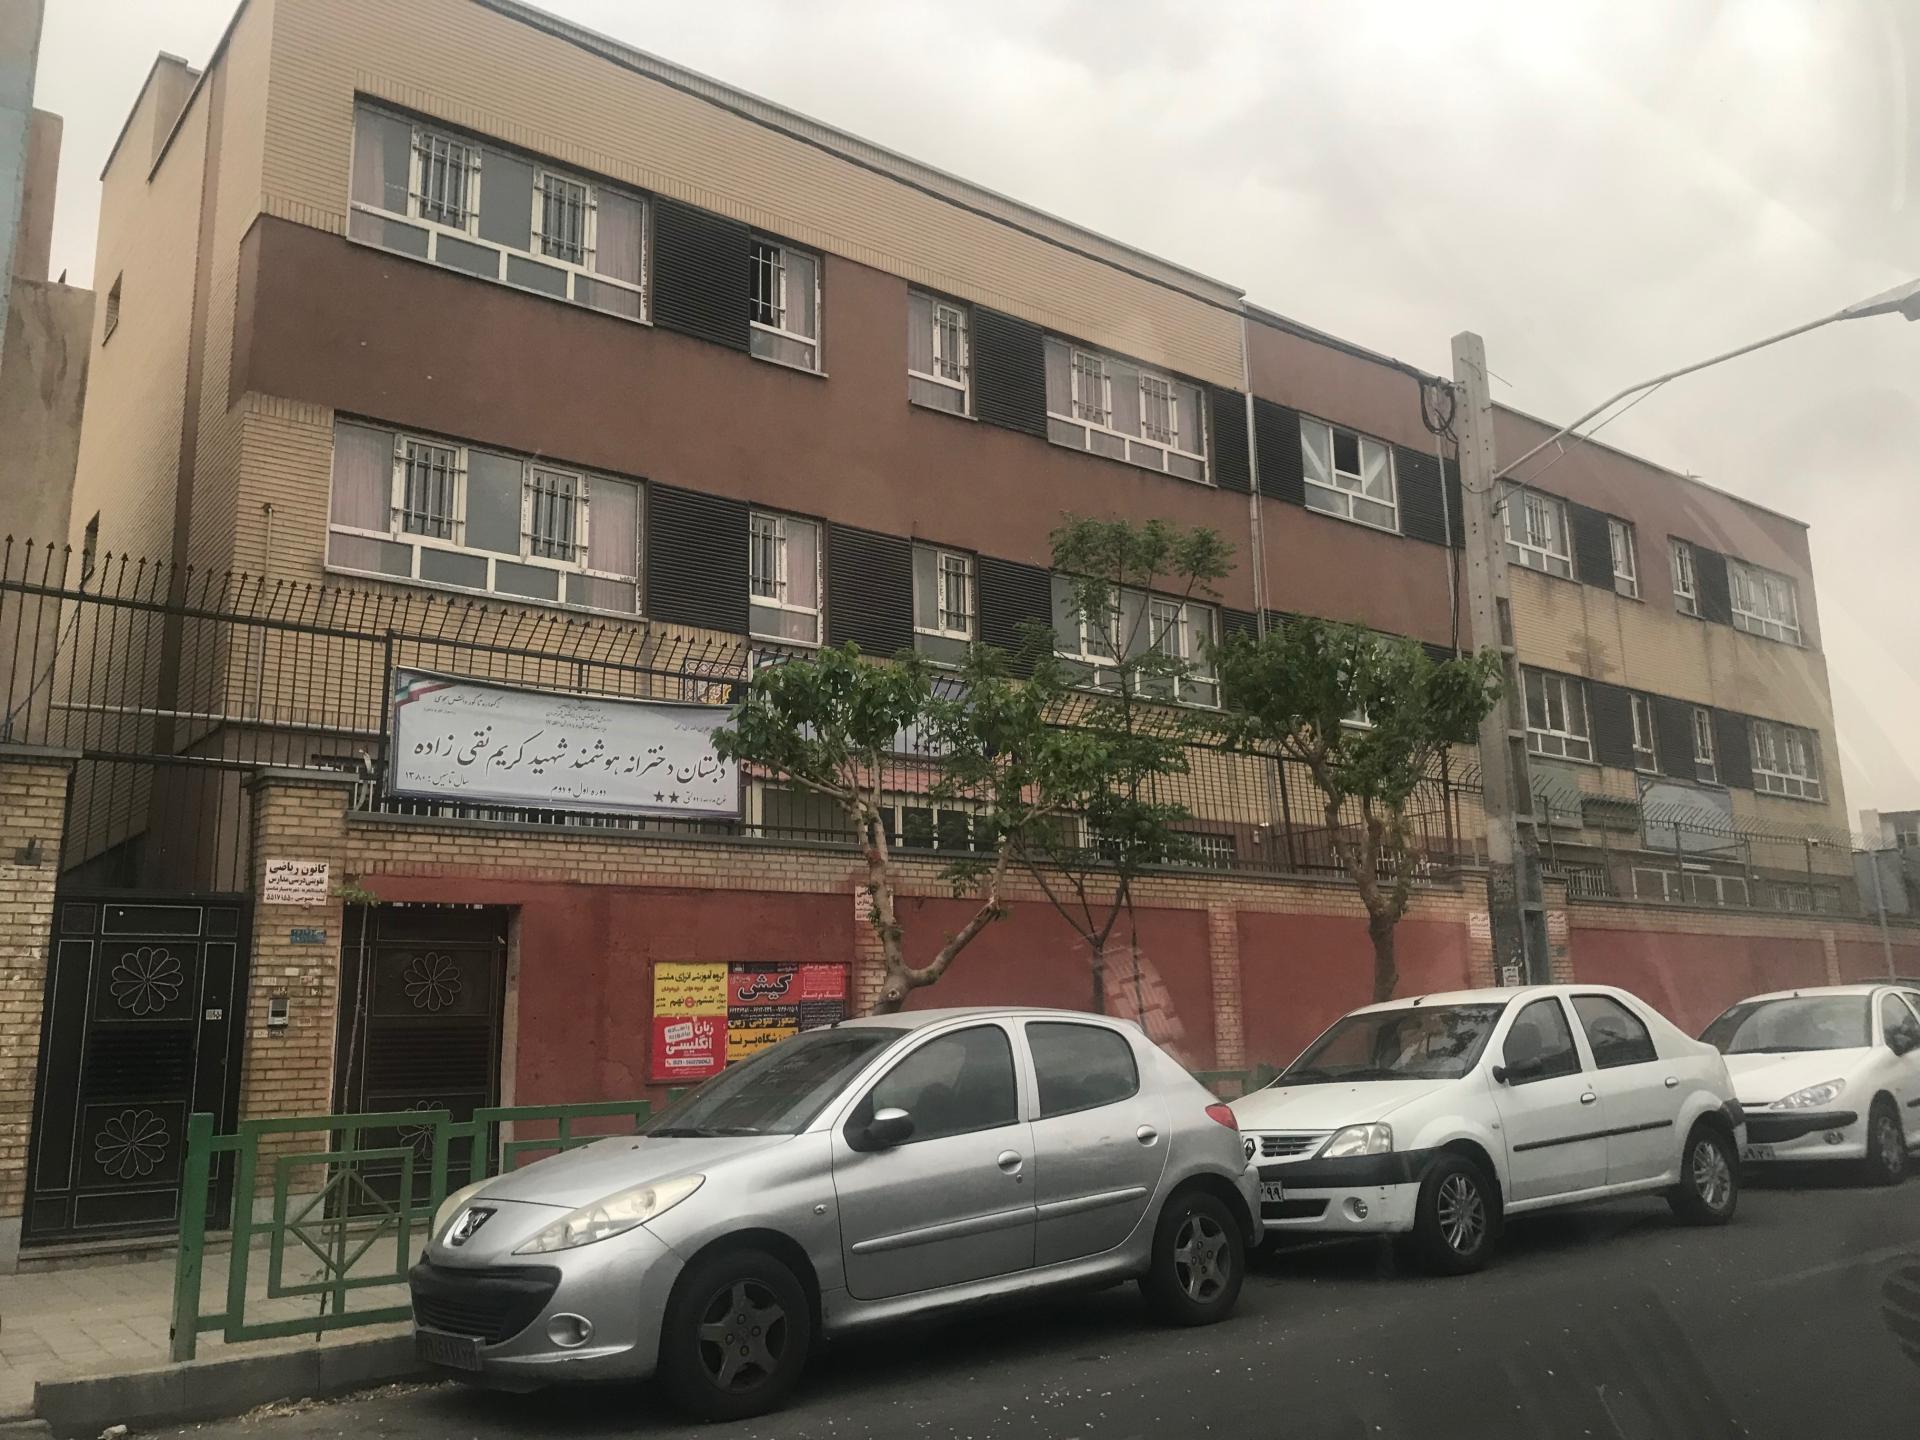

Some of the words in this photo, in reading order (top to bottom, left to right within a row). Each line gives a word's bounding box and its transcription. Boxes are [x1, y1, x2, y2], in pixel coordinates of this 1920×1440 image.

[457, 725, 492, 766] نقی
[486, 730, 545, 777] کریم
[528, 738, 568, 775] شهید
[569, 739, 620, 776] هوشمند
[624, 745, 674, 777] دخترانه
[677, 756, 726, 784] دبستان
[269, 861, 299, 876] ریاضی
[301, 863, 327, 876] کانون
[738, 974, 793, 1001] کیش
[665, 1034, 713, 1056] انگلیسی
